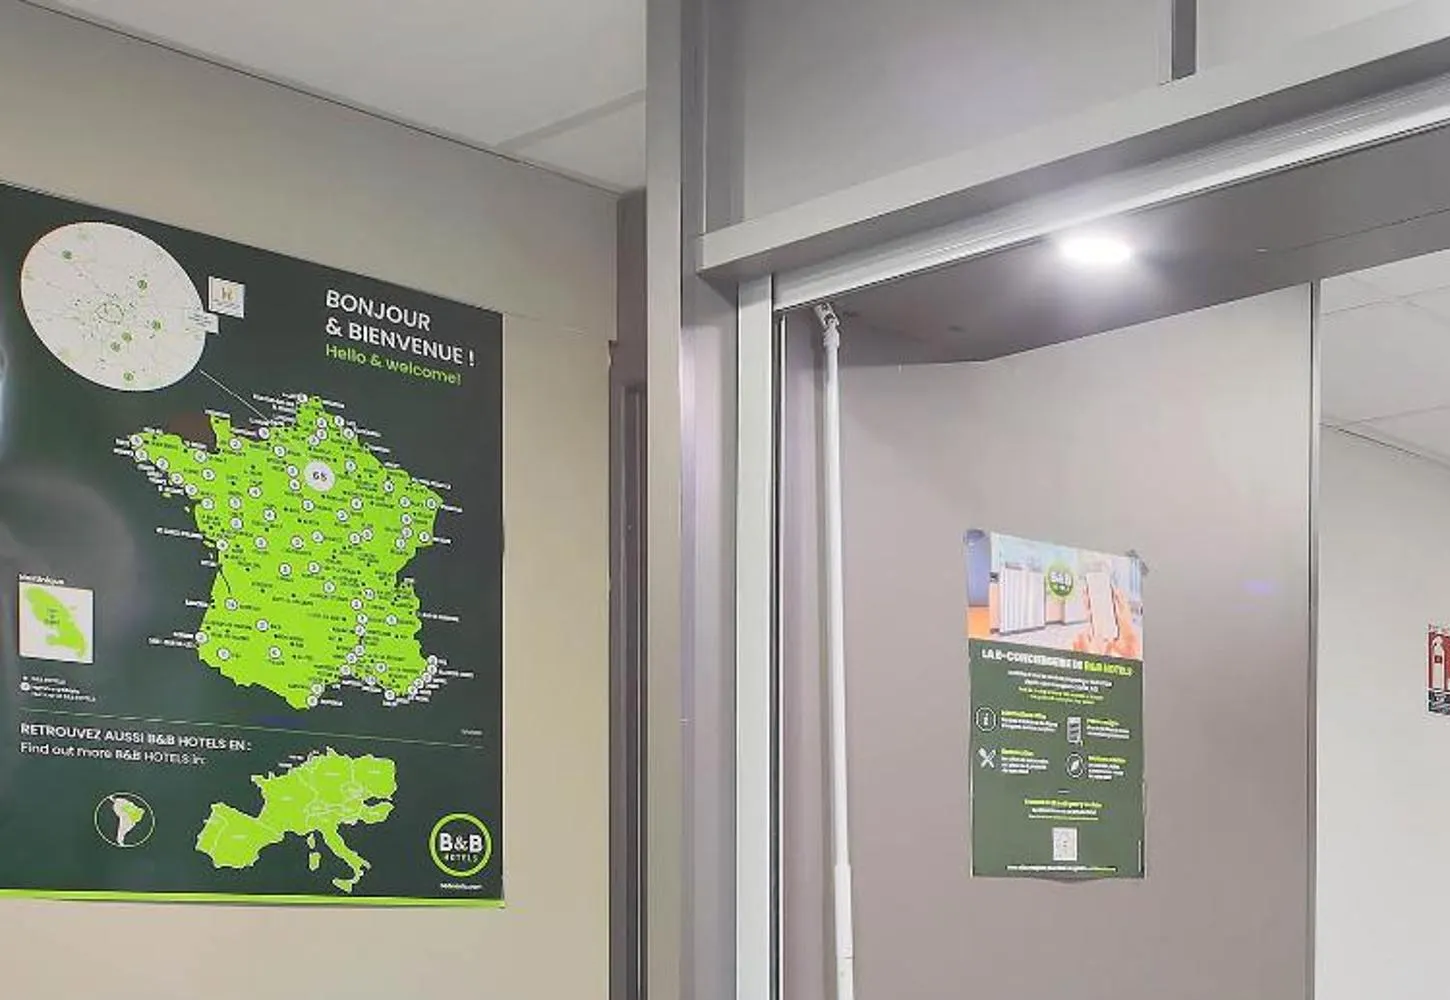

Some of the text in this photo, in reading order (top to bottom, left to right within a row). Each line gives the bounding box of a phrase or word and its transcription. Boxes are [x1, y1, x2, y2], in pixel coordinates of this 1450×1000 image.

[326, 289, 430, 331] BONJOUR
[325, 317, 475, 366] & BIENVENUE !
[326, 344, 462, 386] Hello & welcome!
[20, 722, 101, 740] RETROUVEZ
[104, 729, 144, 744] AUSSI
[147, 733, 175, 746] B&B
[178, 735, 226, 750] HOTELS
[229, 740, 245, 751] EN
[20, 742, 49, 755] Find
[51, 746, 75, 757] out
[77, 748, 112, 759] more
[115, 749, 141, 761] B&B
[144, 751, 190, 765] HOTELS
[440, 832, 483, 853] B&B
